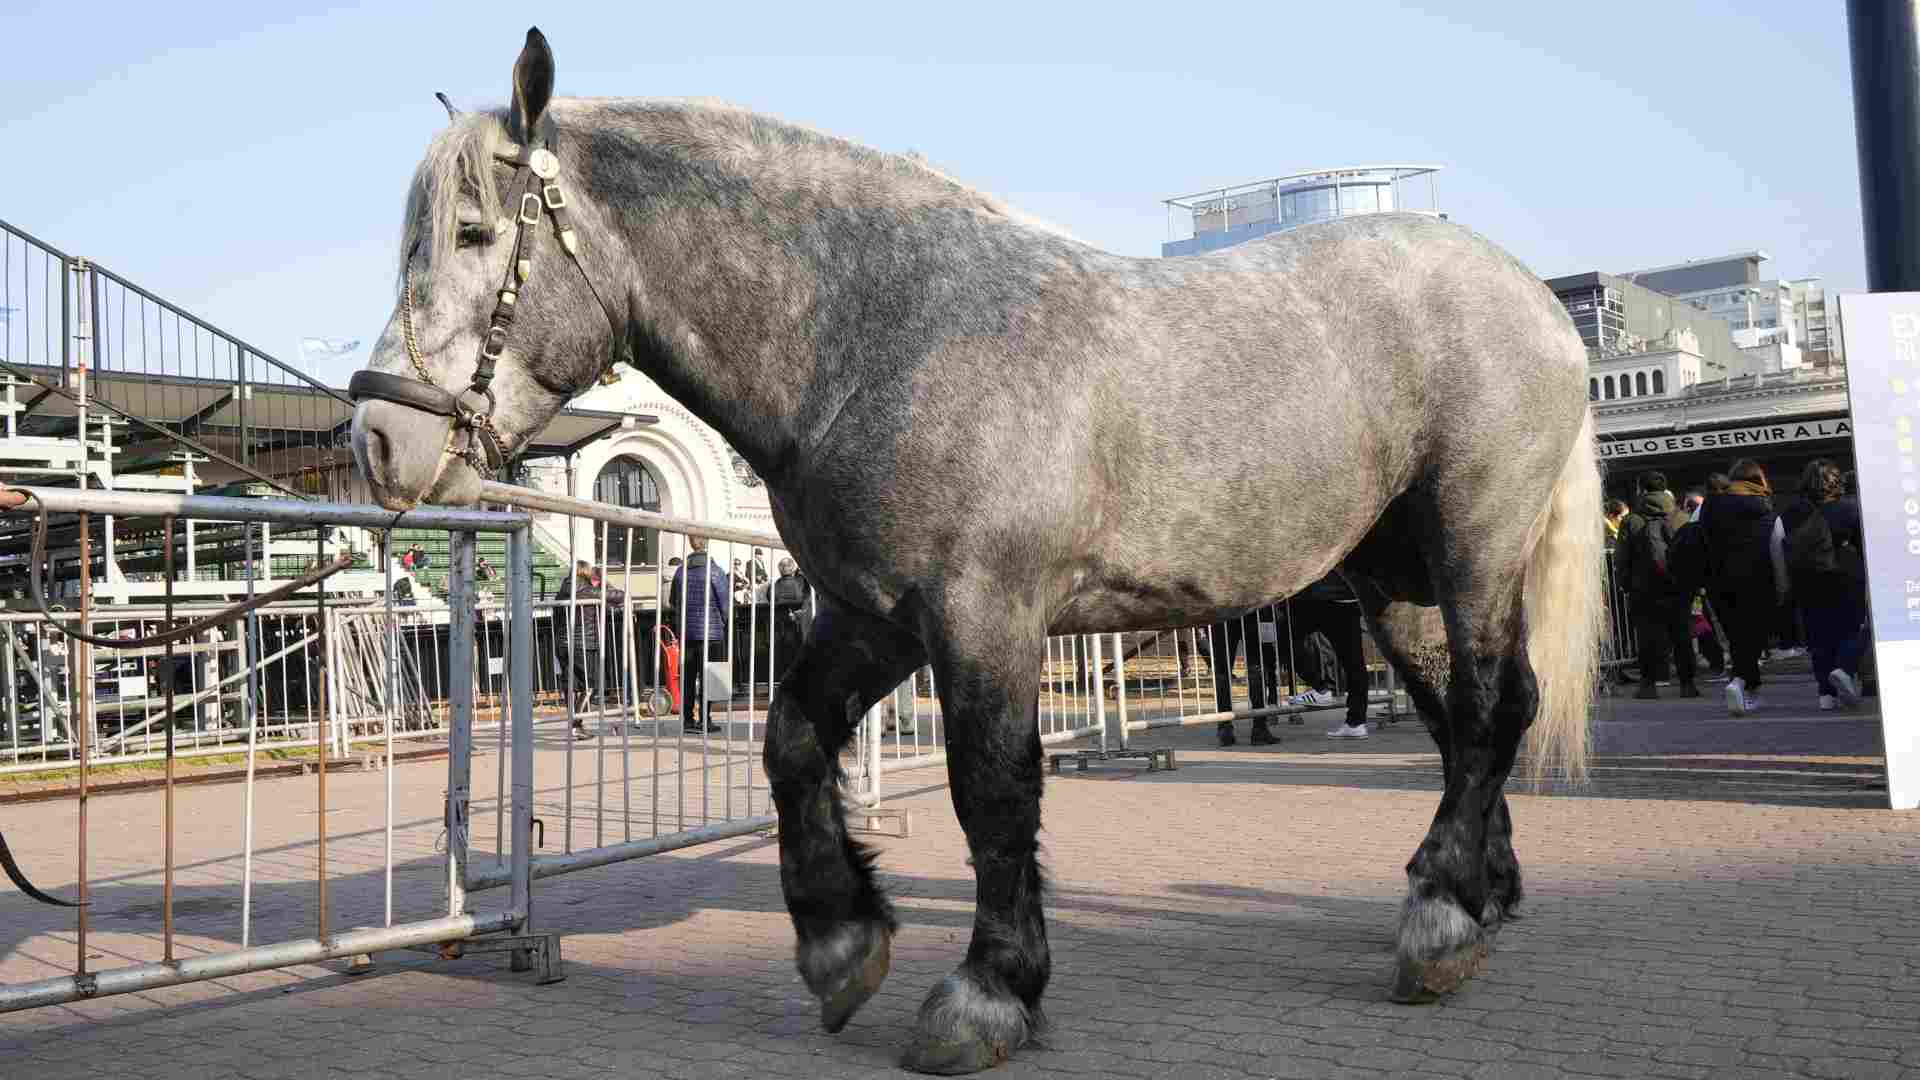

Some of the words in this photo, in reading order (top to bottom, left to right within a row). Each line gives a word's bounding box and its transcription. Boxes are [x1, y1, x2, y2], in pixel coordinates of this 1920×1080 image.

[1665, 436, 1694, 450] ES
[1701, 427, 1785, 447] SERVIR
[1794, 425, 1811, 438] A
[1817, 422, 1851, 435] LA
